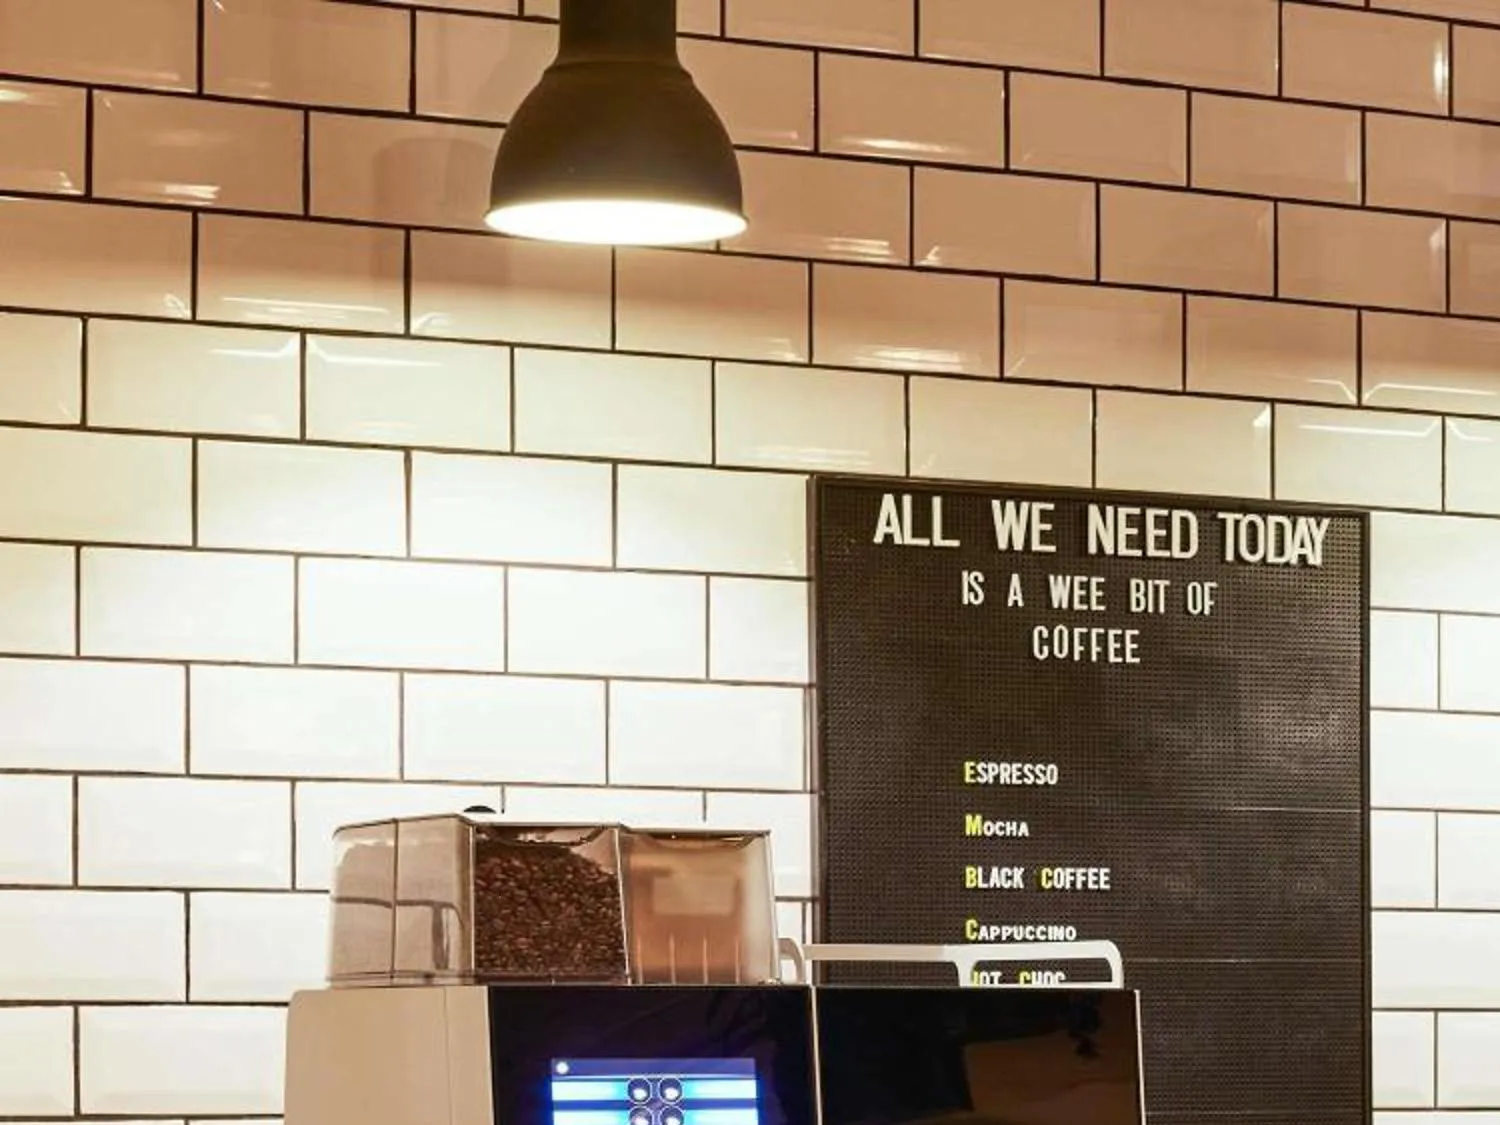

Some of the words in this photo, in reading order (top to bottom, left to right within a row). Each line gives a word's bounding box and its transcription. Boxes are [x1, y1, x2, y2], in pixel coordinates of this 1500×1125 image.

[873, 493, 960, 547] ALL
[992, 499, 1056, 552] WE
[1087, 504, 1199, 559] NEED
[1217, 511, 1331, 567] TODAY
[961, 571, 985, 605] IS
[1007, 573, 1024, 607] A
[1048, 575, 1106, 611] WEE
[1129, 578, 1170, 614] BIT
[1187, 581, 1218, 616] OF
[1032, 624, 1141, 663] COFFEE
[964, 761, 1059, 785] ESPRESSO
[965, 866, 1025, 889] BLACK
[1040, 867, 1111, 890] COFFEE
[972, 970, 1002, 984] OT
